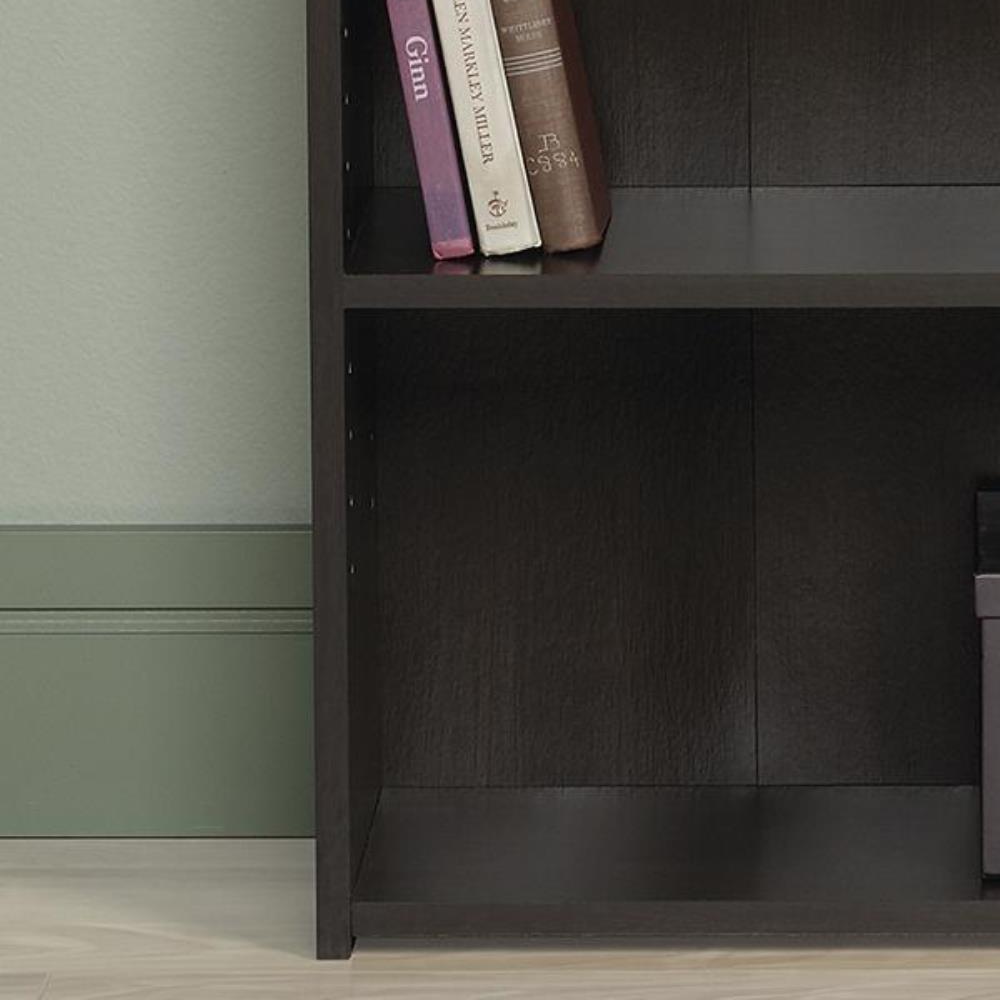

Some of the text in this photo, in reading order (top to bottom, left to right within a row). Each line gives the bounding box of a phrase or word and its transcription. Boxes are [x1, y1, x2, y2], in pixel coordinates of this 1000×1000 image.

[405, 36, 430, 101] Ginn
[458, 26, 484, 102] MARKLEY
[473, 104, 494, 166] MILLER
